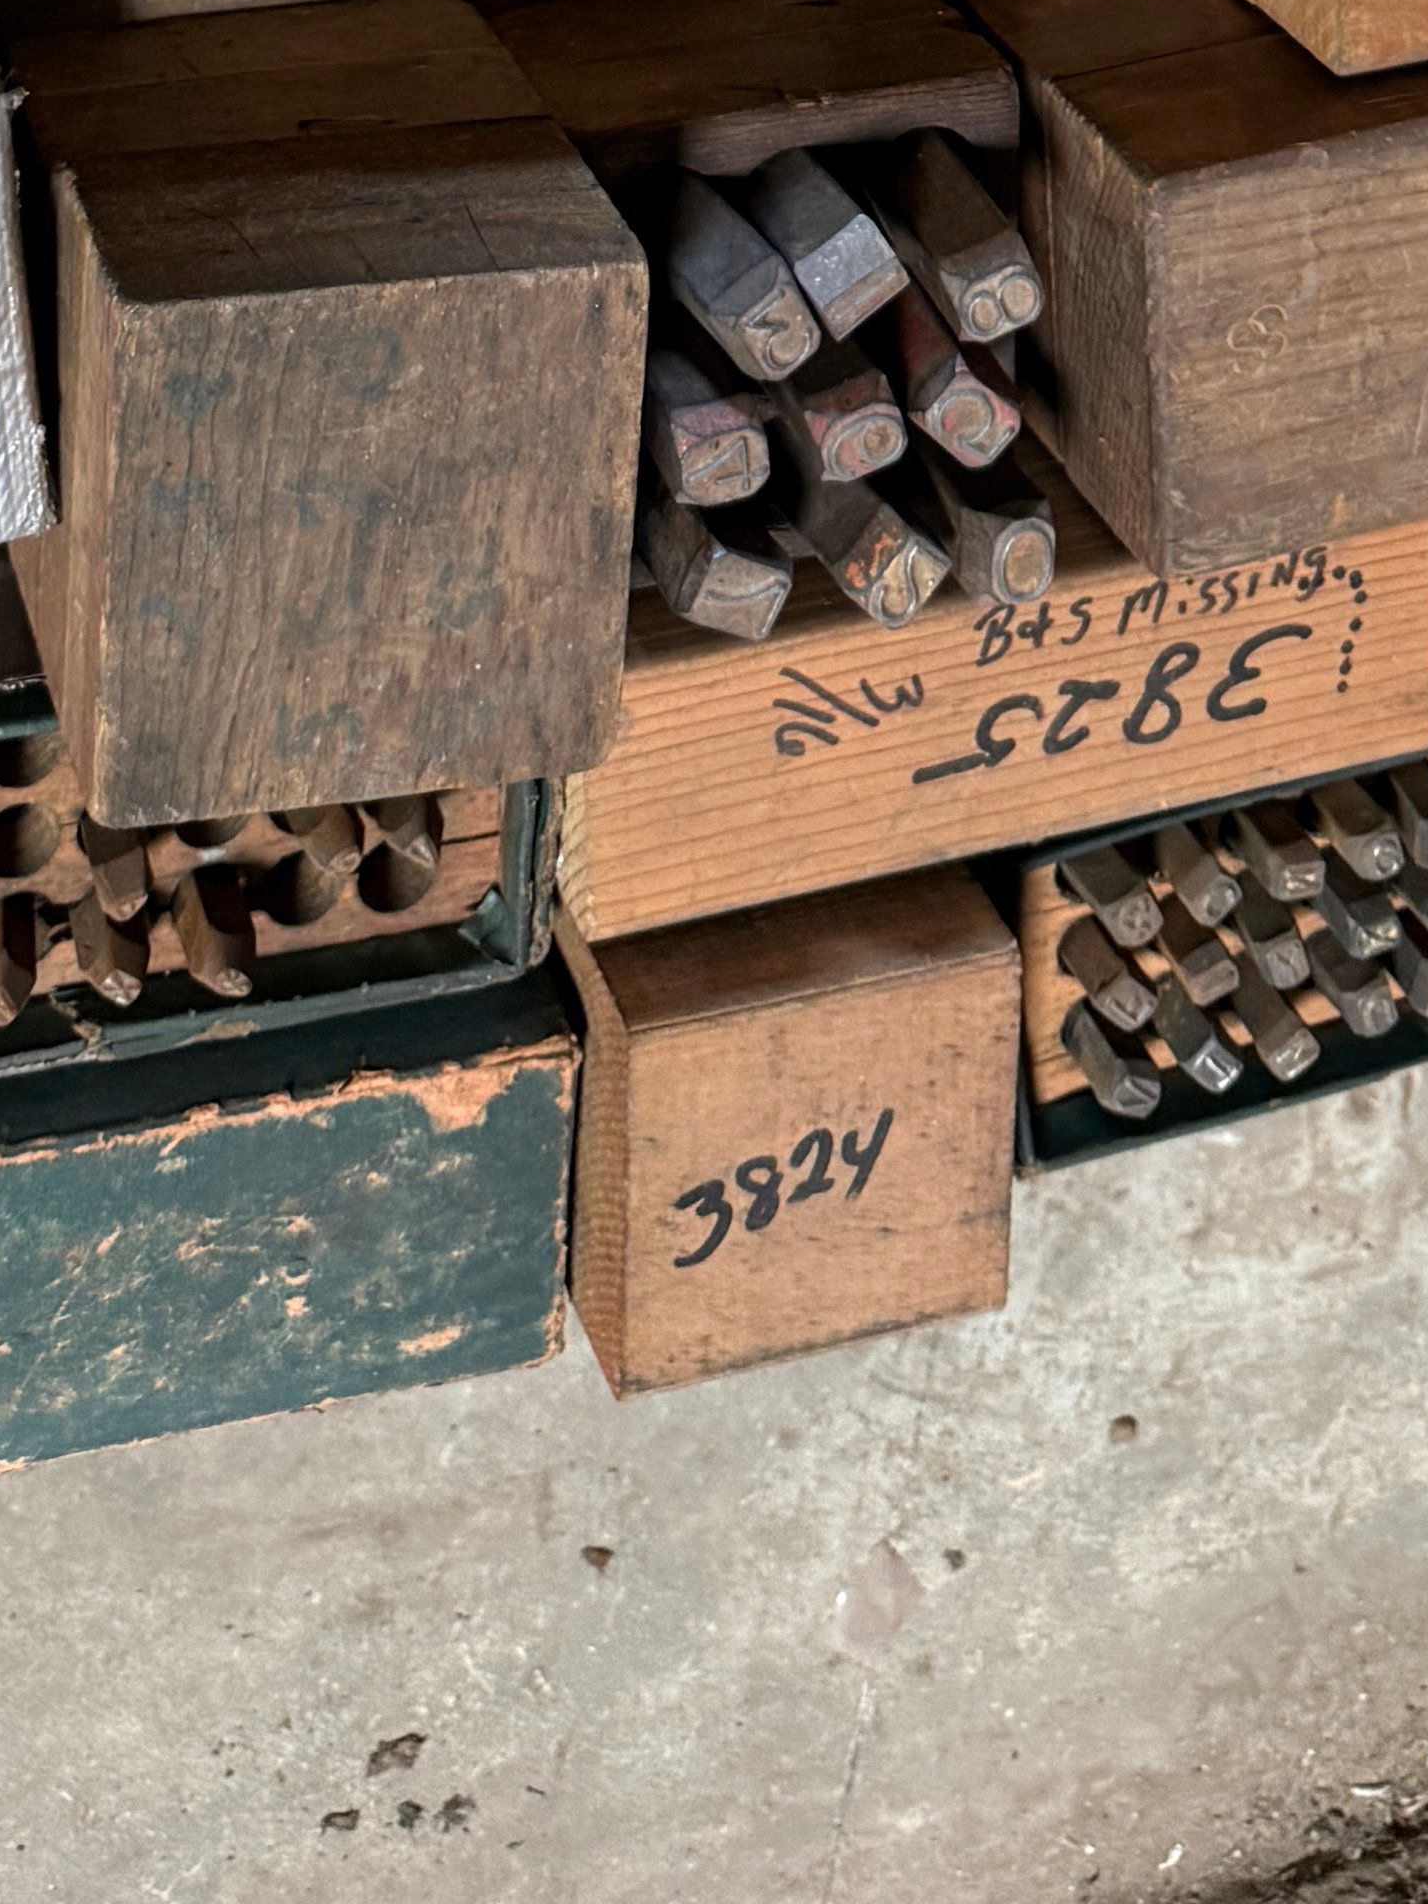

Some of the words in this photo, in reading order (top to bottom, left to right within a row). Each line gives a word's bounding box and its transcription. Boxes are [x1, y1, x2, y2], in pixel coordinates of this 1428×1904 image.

[772, 666, 925, 758] 3/16
[912, 624, 1314, 784] 3825
[672, 1108, 895, 1268] 3824
